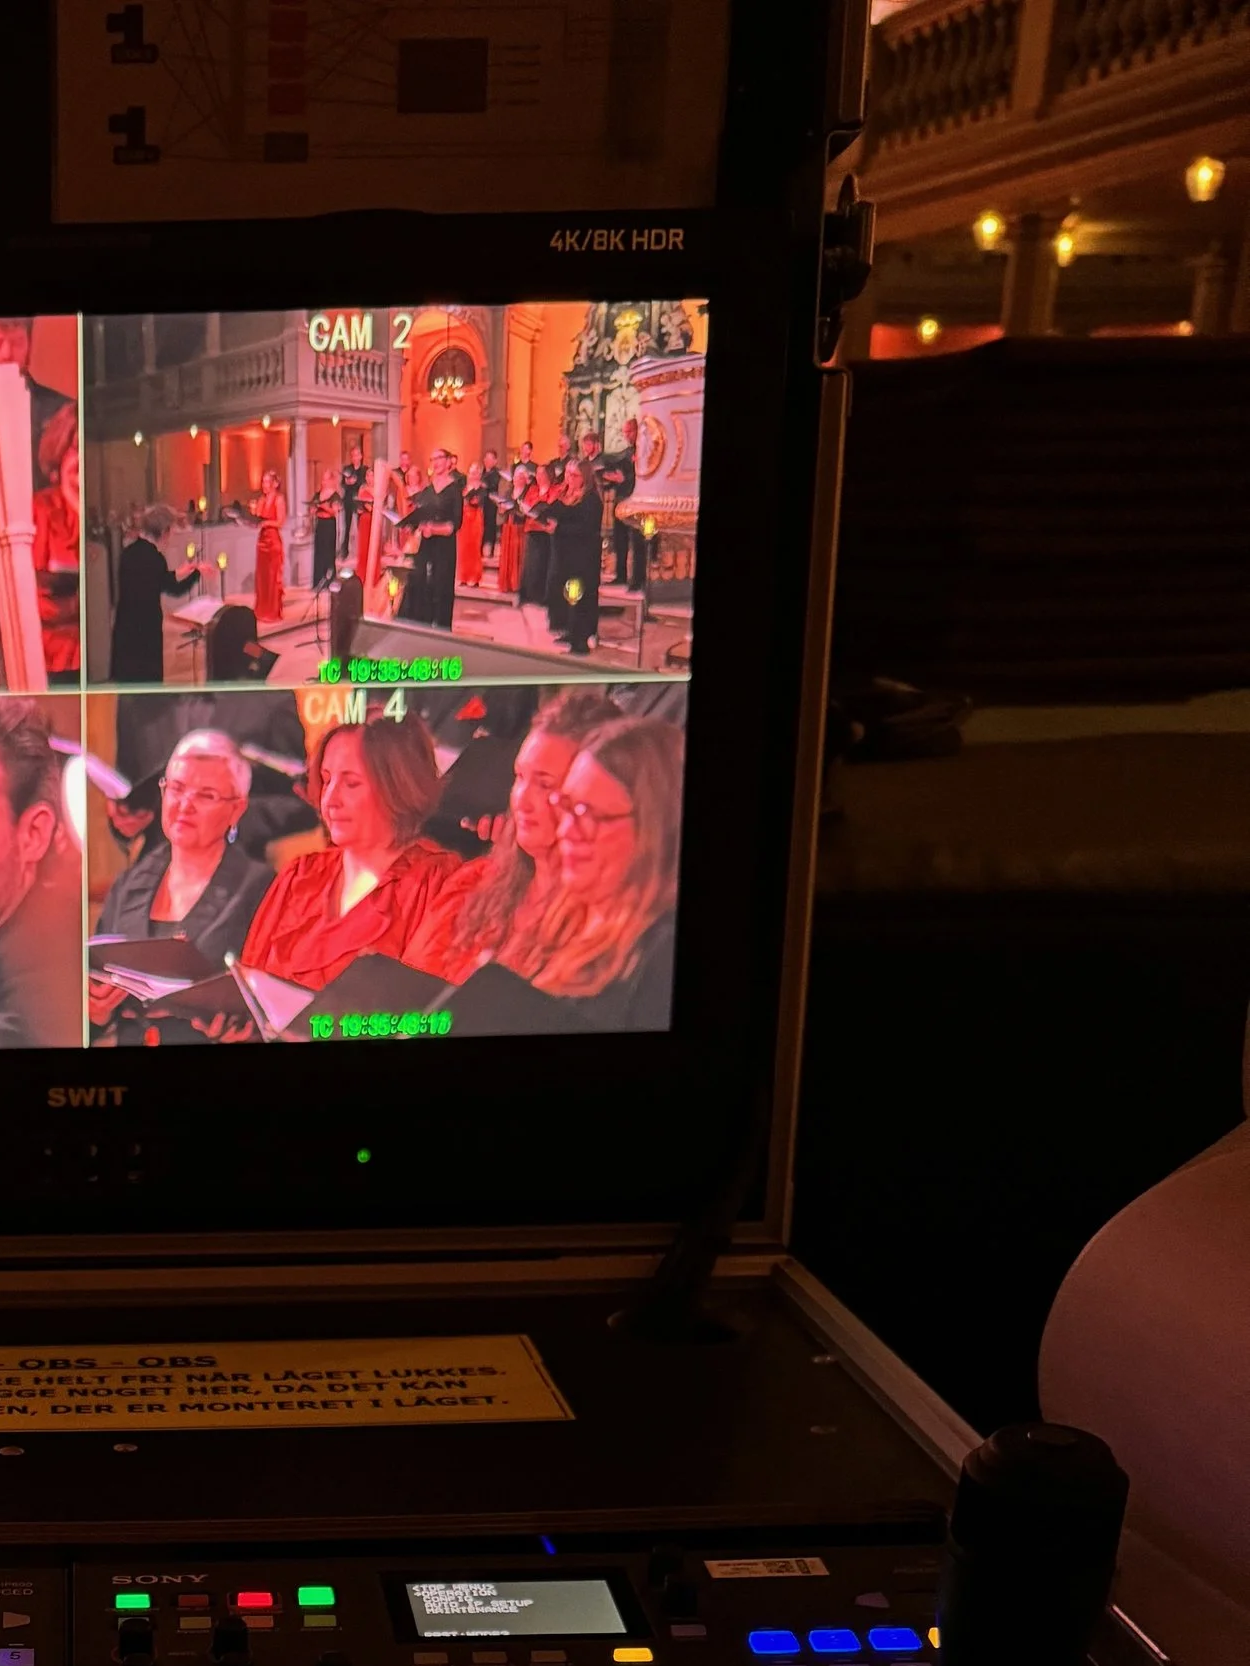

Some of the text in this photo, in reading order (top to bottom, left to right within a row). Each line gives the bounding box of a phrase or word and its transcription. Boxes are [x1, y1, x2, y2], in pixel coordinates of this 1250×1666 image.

[550, 229, 684, 252] 4K/8K HDR
[309, 314, 411, 351] CAM 2
[305, 689, 406, 725] CAM 4
[47, 1086, 128, 1107] SWIT
[18, 1359, 97, 1370] OBS
[138, 1357, 217, 1368] OBS
[33, 1376, 111, 1386] HELT
[122, 1374, 173, 1384] FRI
[372, 1366, 506, 1378] LUKKES.
[68, 1387, 180, 1398] NOGET
[187, 1386, 260, 1397] HER,
[273, 1384, 317, 1394] DA
[328, 1382, 389, 1393] DET
[400, 1380, 467, 1391] KAN
[51, 1404, 114, 1414] DER
[128, 1403, 167, 1413] ER
[179, 1400, 353, 1413] MONTERET
[371, 1398, 384, 1408] I
[111, 1574, 209, 1584] SONY
